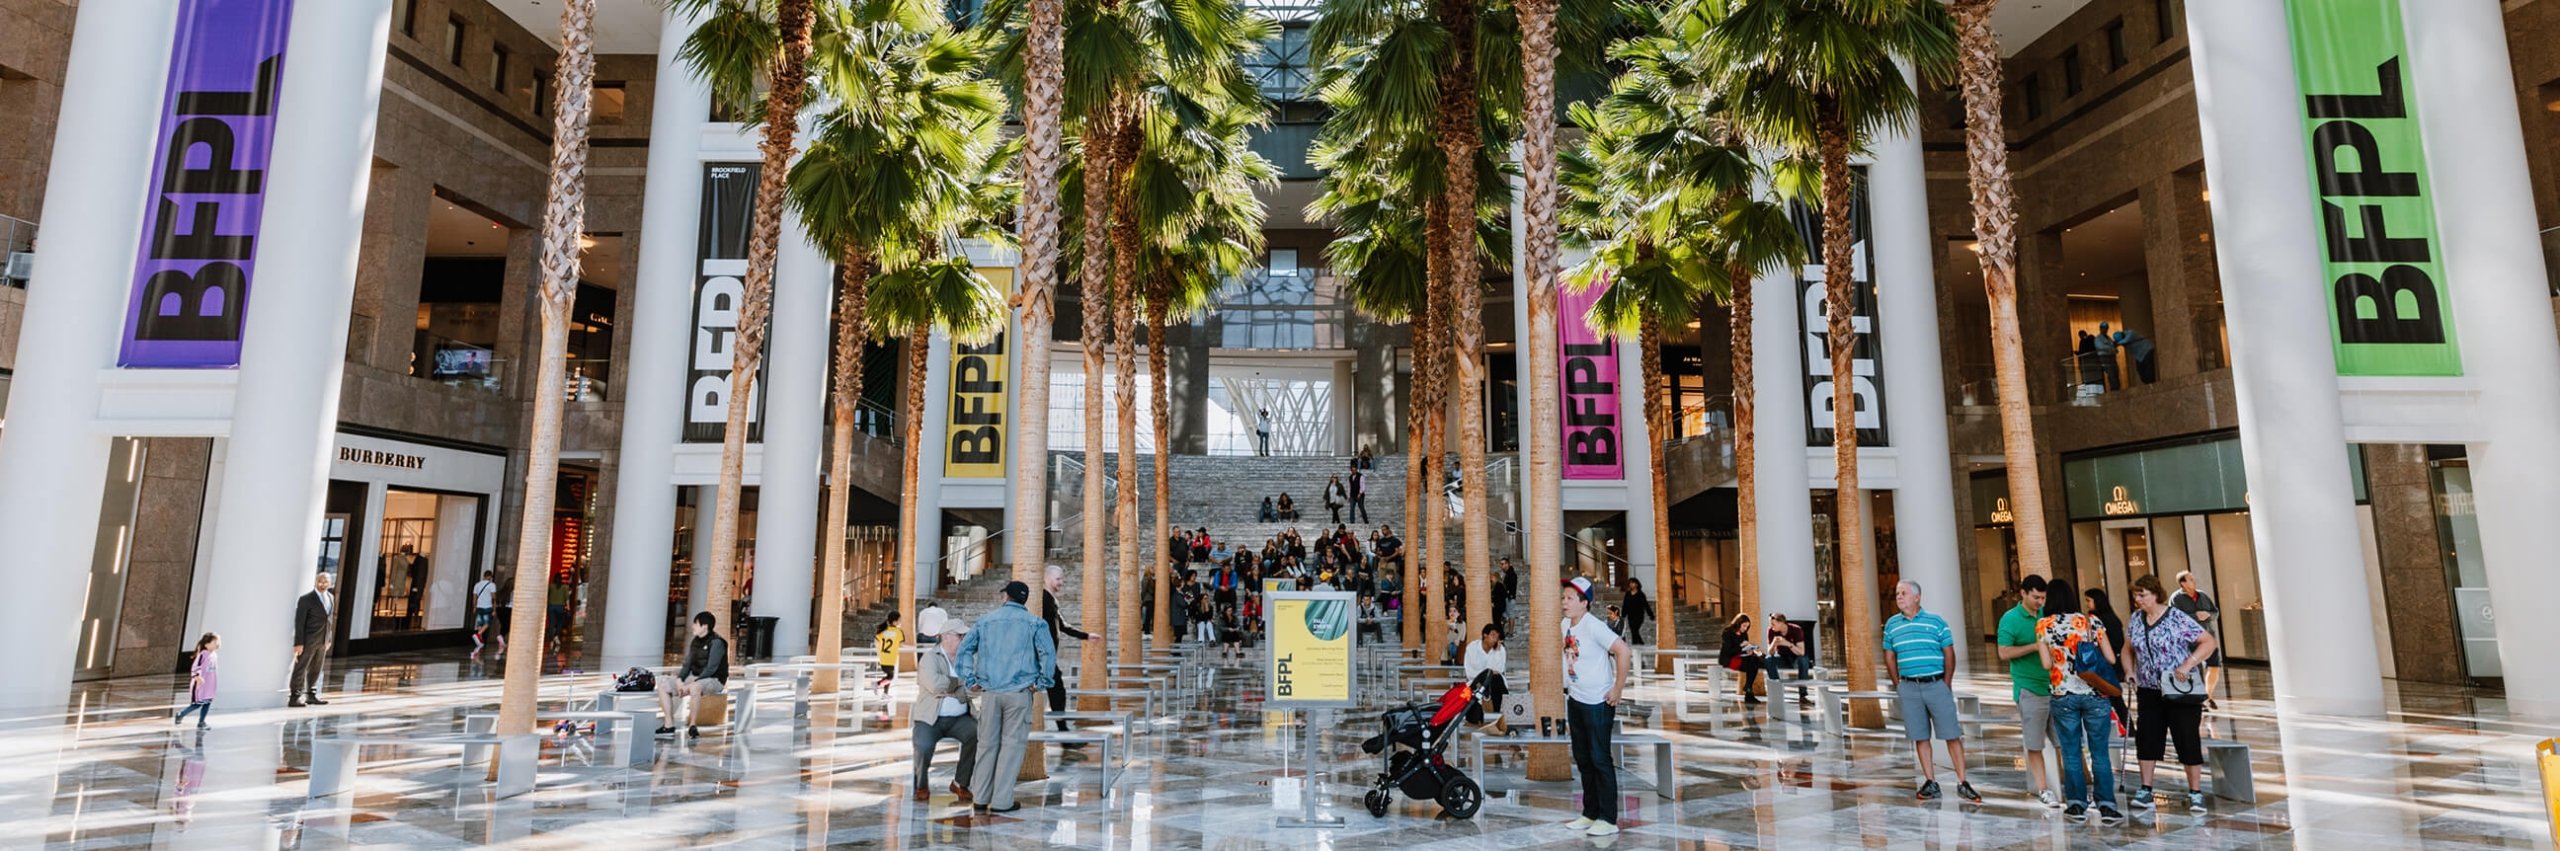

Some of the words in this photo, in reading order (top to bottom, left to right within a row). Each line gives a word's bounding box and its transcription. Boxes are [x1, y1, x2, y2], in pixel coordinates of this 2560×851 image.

[135, 53, 281, 341] BFPL
[2305, 55, 2446, 344] BFPL
[951, 330, 1004, 464] BFPL
[1564, 335, 1617, 465] BFPL
[340, 446, 426, 469] BURBERRY
[1991, 510, 2013, 523] OMEGA
[2105, 501, 2135, 515] OMEGA
[881, 638, 893, 653] 12
[1277, 653, 1292, 696] BFPL
